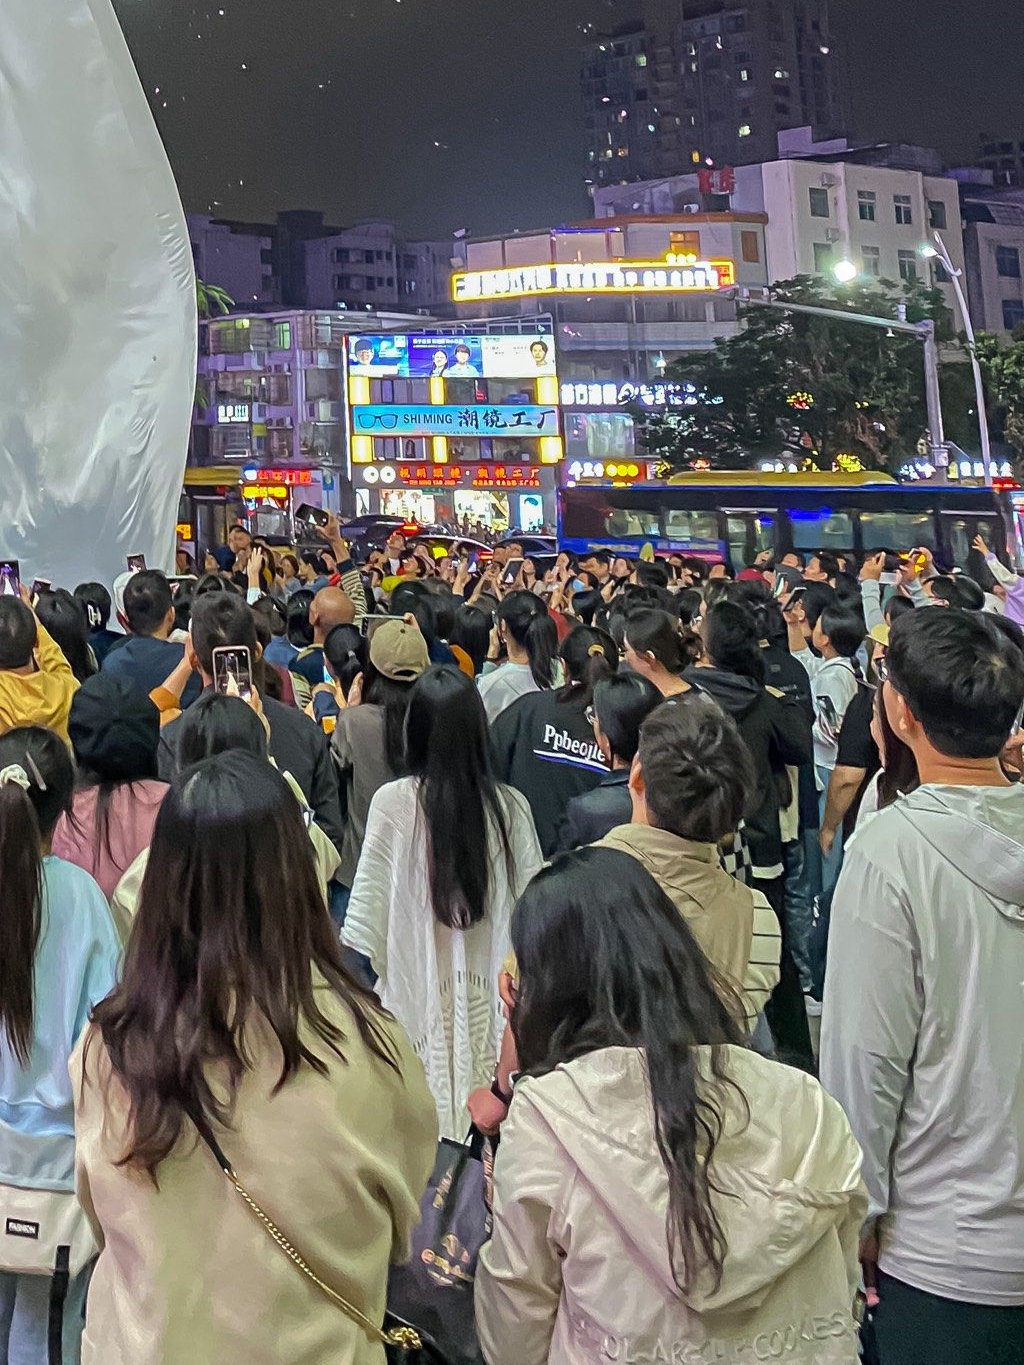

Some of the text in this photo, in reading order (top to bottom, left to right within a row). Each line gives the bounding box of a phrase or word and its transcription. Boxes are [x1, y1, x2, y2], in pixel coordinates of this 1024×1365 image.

[403, 414, 453, 425] SHI MING
[458, 408, 555, 429] 潮镜工厂
